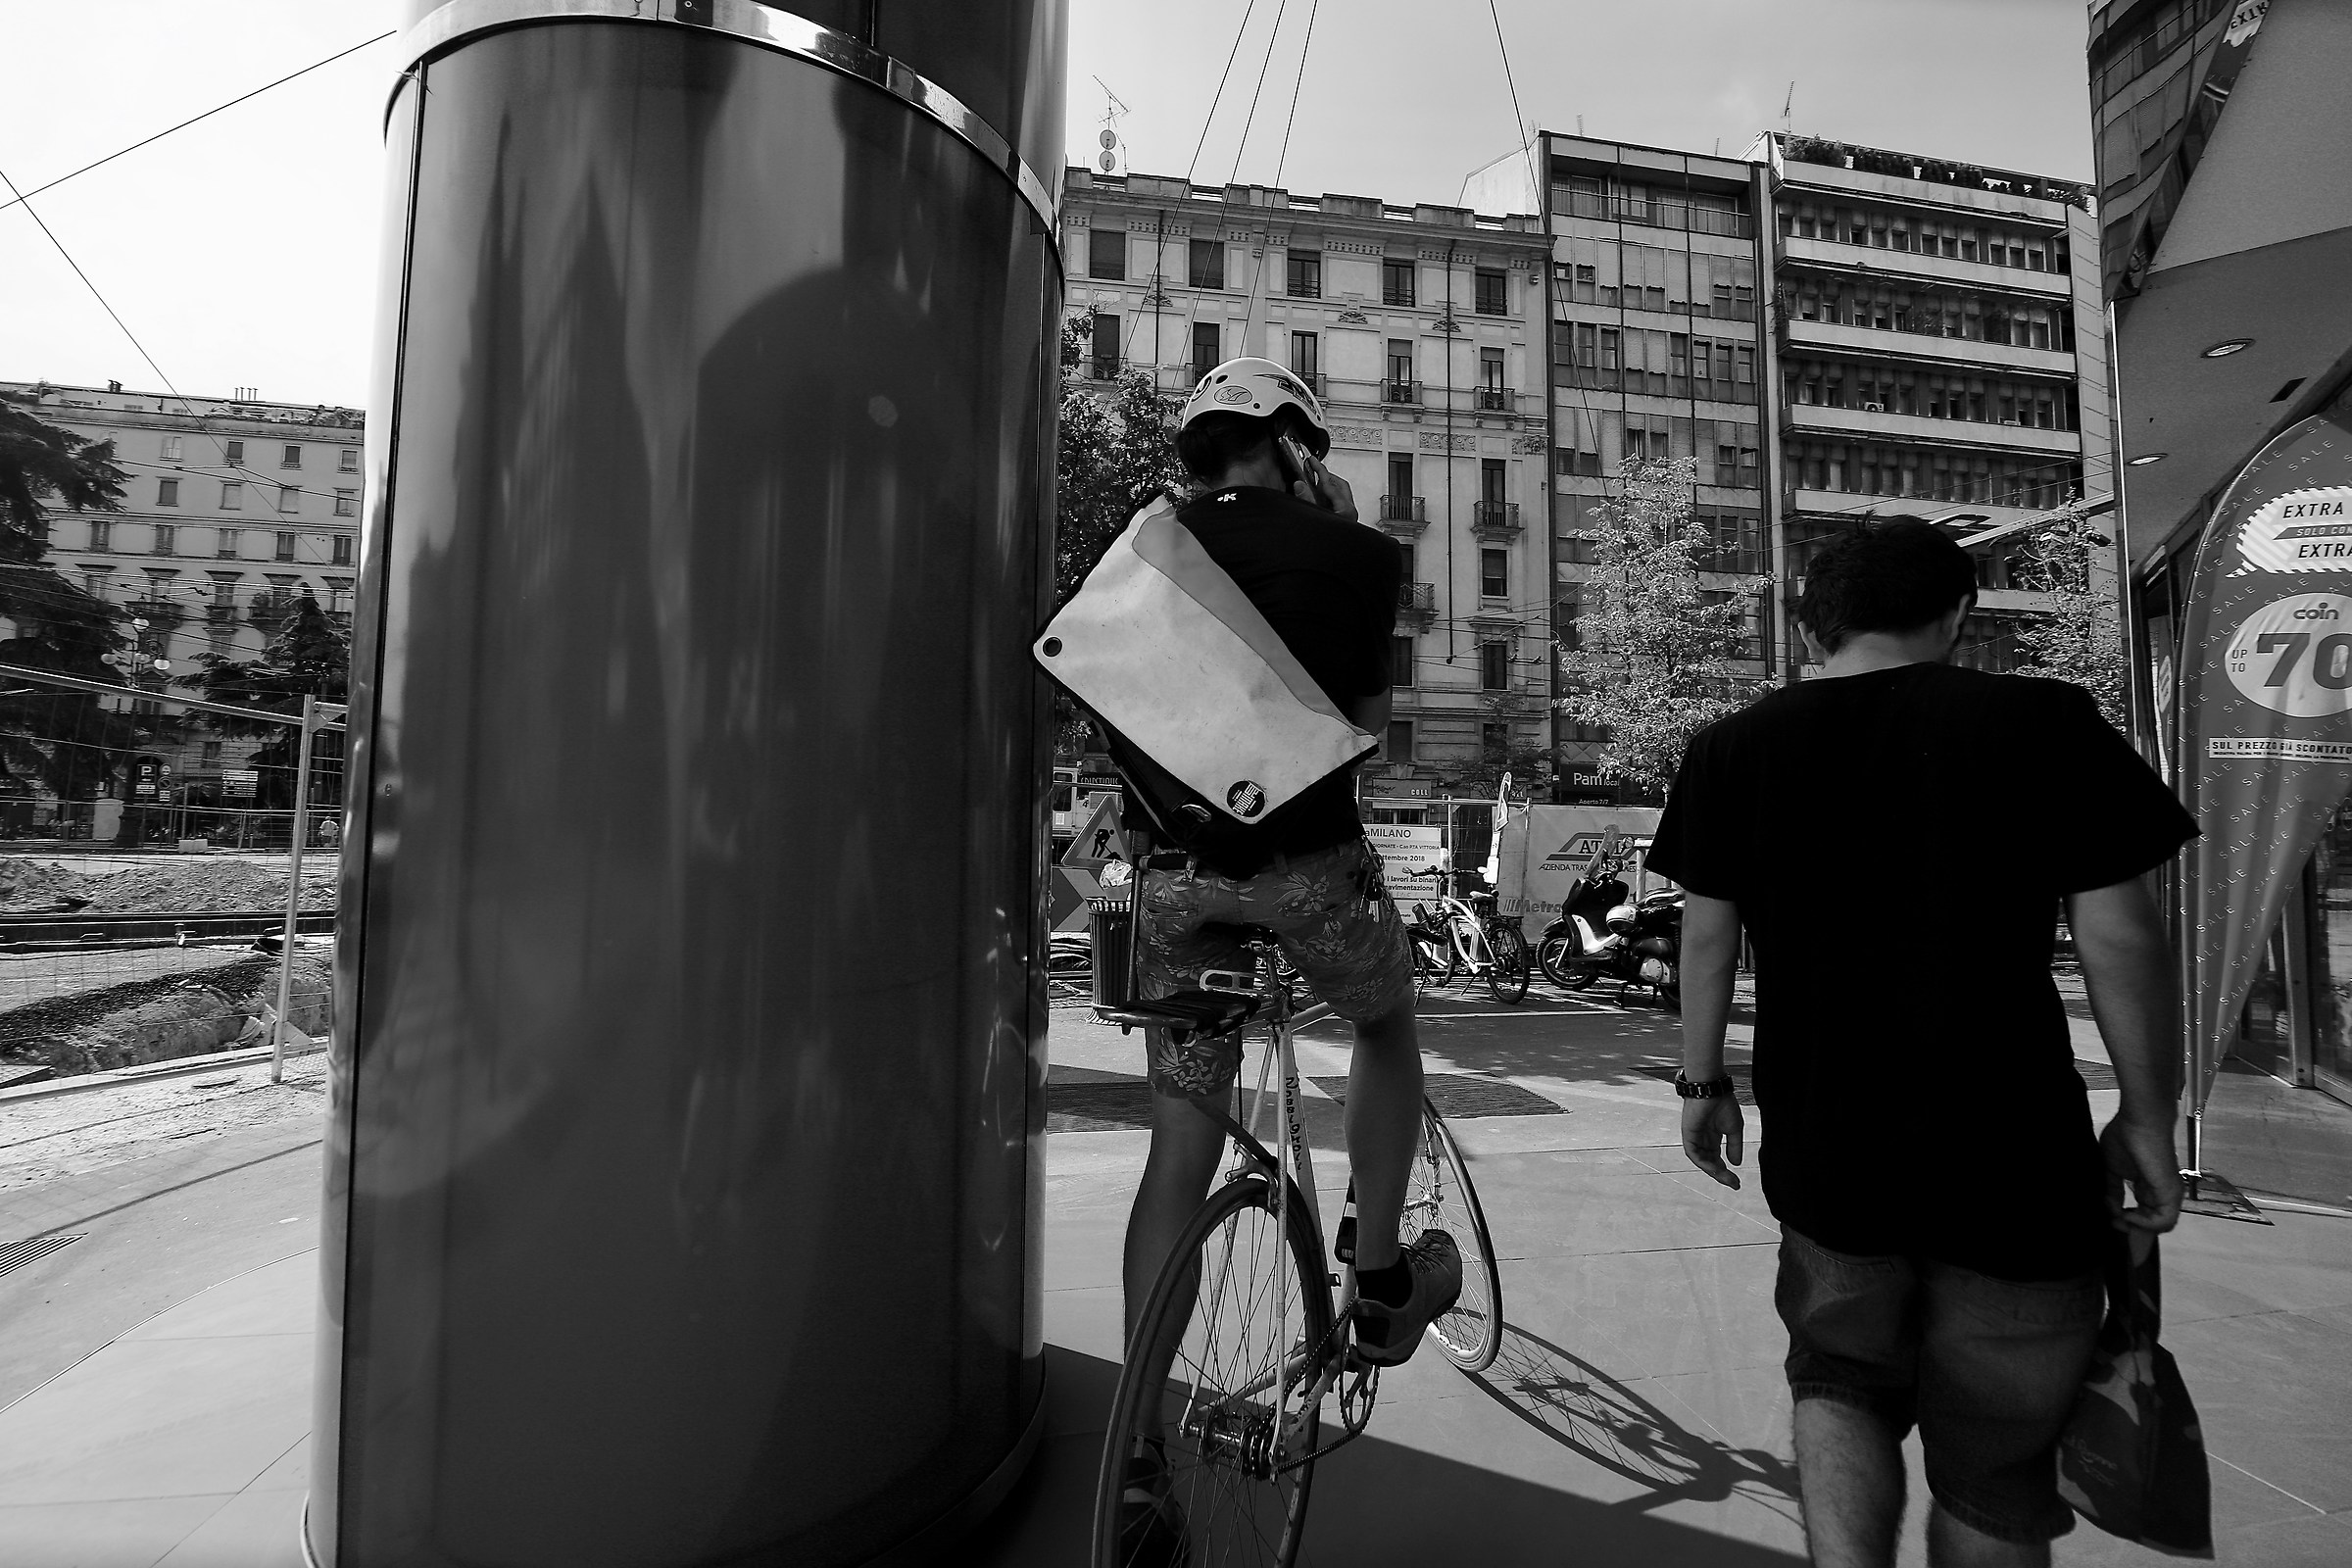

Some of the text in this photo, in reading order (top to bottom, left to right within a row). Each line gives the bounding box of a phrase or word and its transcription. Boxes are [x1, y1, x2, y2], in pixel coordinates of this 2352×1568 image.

[2239, 451, 2282, 480] SALE
[2288, 440, 2333, 470] SALE
[2220, 487, 2264, 515] SALE
[2282, 502, 2344, 518] EXTRA
[2297, 527, 2326, 536] SOLO
[2213, 586, 2256, 614] SALE
[2293, 602, 2339, 620] coin
[2199, 621, 2240, 649] SALE
[2231, 649, 2248, 660] UP
[2231, 662, 2246, 672] TO
[2256, 632, 2352, 690] 70
[2179, 661, 2219, 688] SALE
[2180, 693, 2210, 713] ALE
[2212, 741, 2233, 750] SUL
[2237, 741, 2278, 750] PREZZO
[2296, 744, 2352, 755] SCONTATO
[141, 765, 153, 776] P
[1573, 771, 1602, 786] Pam
[2230, 795, 2270, 822] SALE
[2219, 832, 2260, 859] SALE
[2207, 869, 2247, 896] SALE
[2196, 905, 2235, 933] SALE
